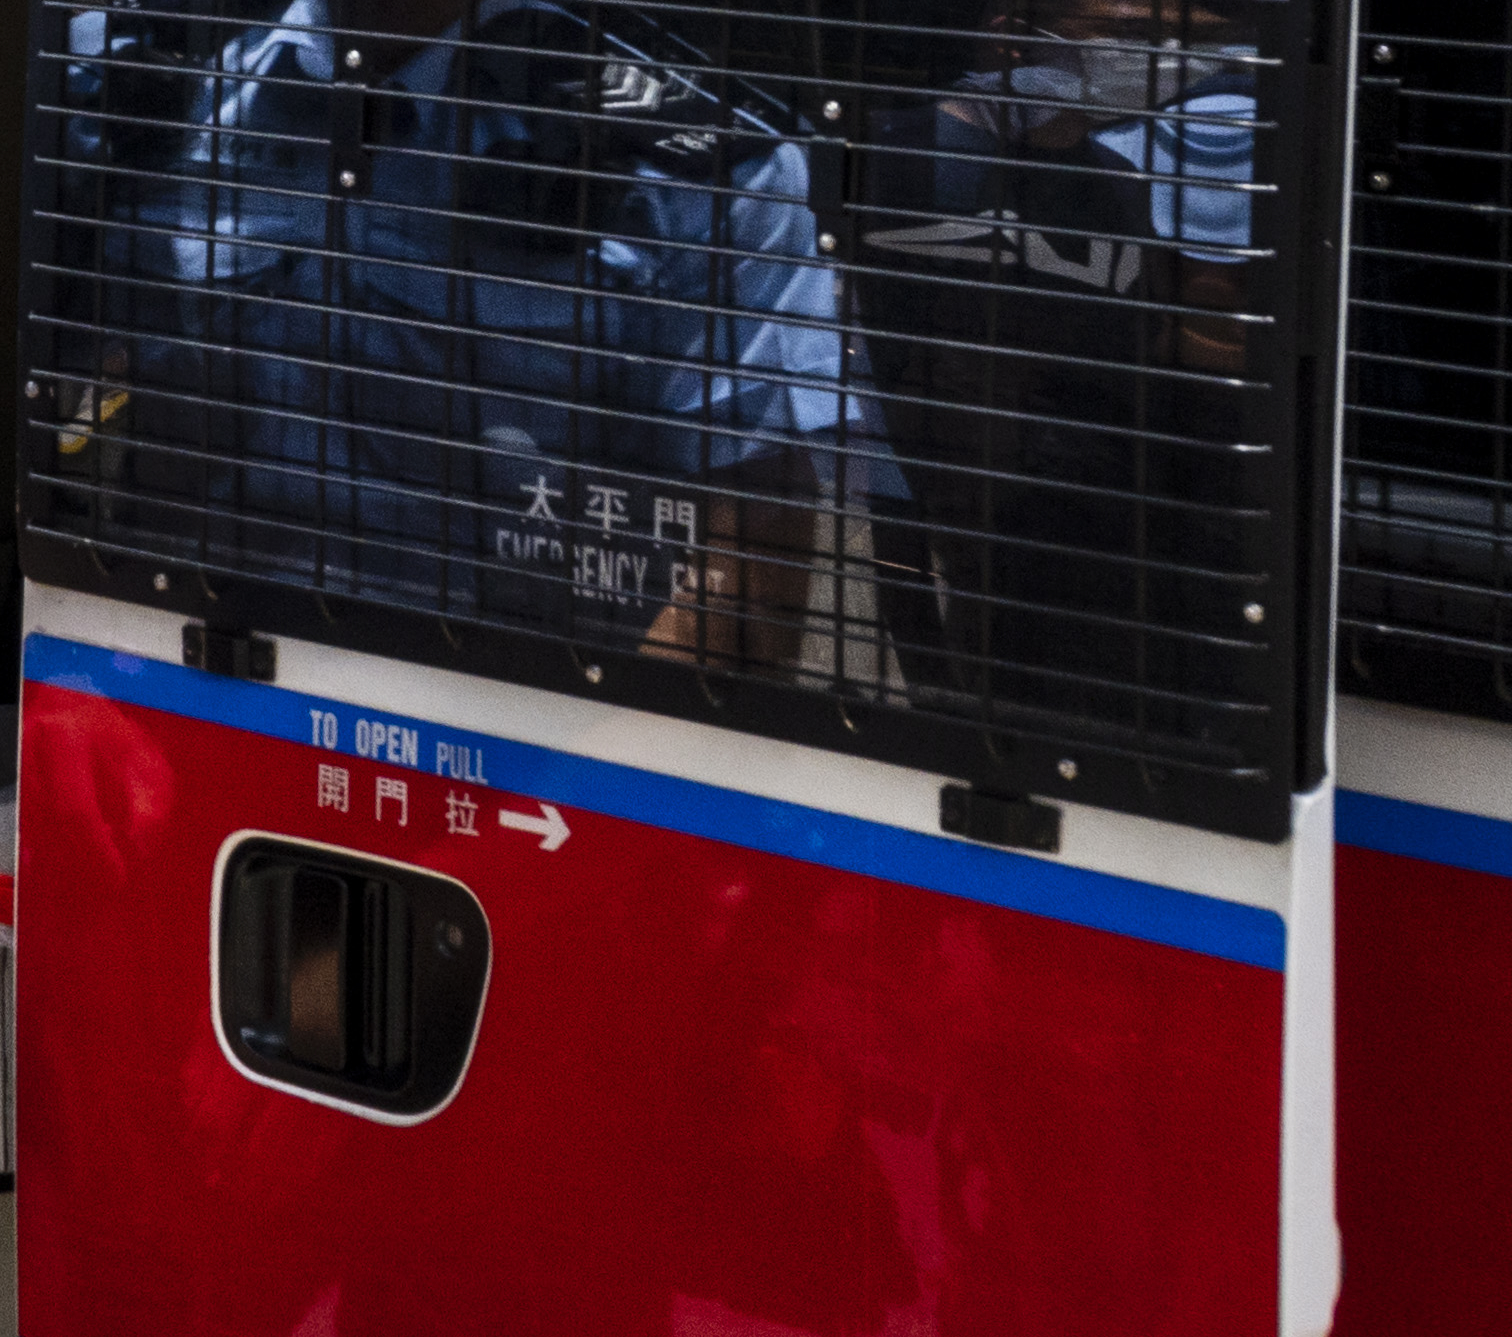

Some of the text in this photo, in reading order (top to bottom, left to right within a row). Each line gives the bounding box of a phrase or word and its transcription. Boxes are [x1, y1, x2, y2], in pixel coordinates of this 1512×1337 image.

[519, 473, 698, 555] 太平門
[309, 708, 489, 786] TO OPEN PULL
[316, 762, 481, 838] 開門拉
